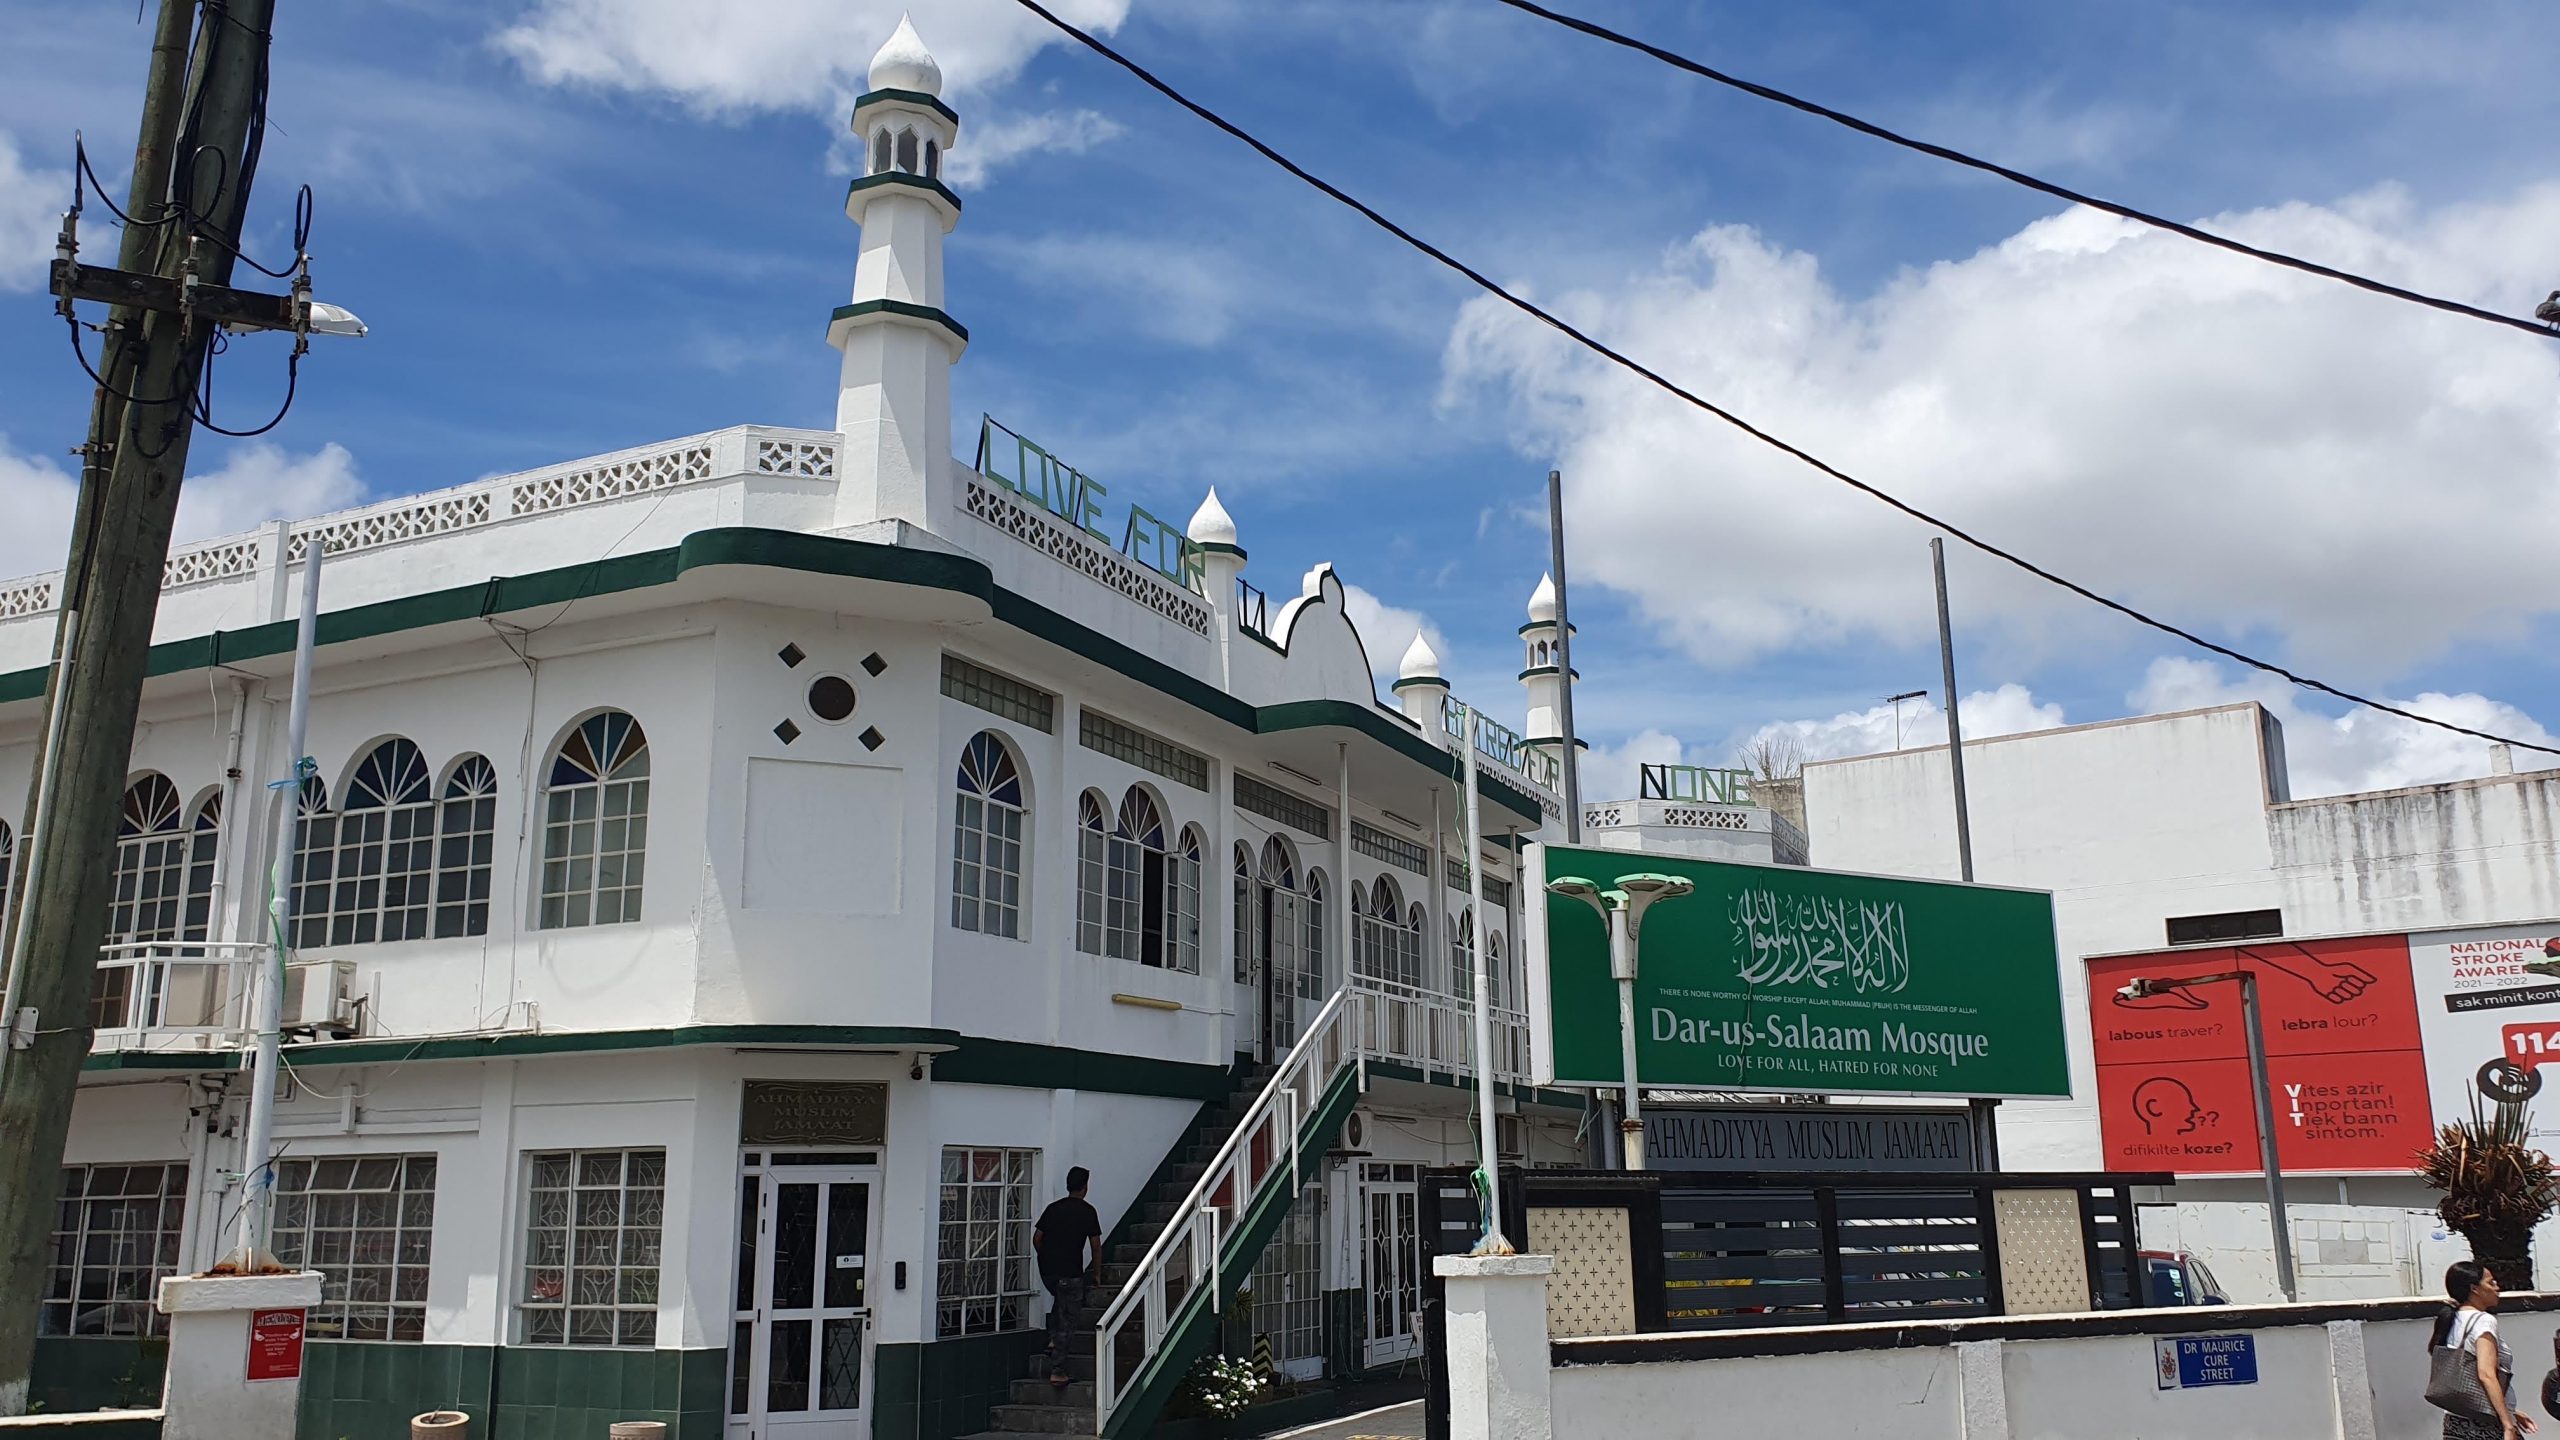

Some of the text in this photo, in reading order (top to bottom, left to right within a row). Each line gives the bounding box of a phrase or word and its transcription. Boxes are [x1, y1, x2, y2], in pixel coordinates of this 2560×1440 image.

[984, 413, 1206, 600] LOVE FOR
[1446, 694, 1521, 775] HTRED
[1640, 763, 1756, 806] NONE
[2450, 939, 2545, 954] NATIONAL
[2451, 952, 2525, 966] STROKE
[2454, 980, 2482, 989] 2021
[2496, 976, 2528, 987] 2022
[1659, 988, 1681, 997] THERE
[1682, 989, 1689, 997] IS
[1690, 990, 1711, 998] NONE
[1712, 991, 1740, 1000] WORTHY
[1752, 994, 1782, 1003] WORSHIP
[1783, 996, 1807, 1004] EXCEPT
[1832, 999, 1871, 1008] MUHAMMAD
[1899, 1003, 1912, 1011] THE
[1912, 1004, 1948, 1013] MESSENGER
[2456, 997, 2482, 1008] sak
[2484, 992, 2524, 1005] minit
[2282, 1013, 2378, 1031] lebra lour?
[1651, 1007, 1989, 1066] Dar-us-Salaam Mosque
[2109, 1023, 2224, 1041] labous traver?
[2510, 1031, 2560, 1054] 114
[1718, 1054, 1939, 1077] LOVE FOR ALL, HATRED FOR NONE
[2284, 1081, 2384, 1098] Vites azir
[754, 1094, 876, 1105] AHMADIYYA
[2291, 1095, 2394, 1115] Inportan!
[773, 1107, 856, 1117] MUSLIM
[2289, 1111, 2398, 1127] Tiek bann
[1648, 1118, 1960, 1160] AHMADIYYA MUSLIM JAMA'AT
[2306, 1126, 2385, 1140] sintom.
[2123, 1142, 2233, 1156] difikilte koze?
[2184, 1340, 2246, 1354] DR MAURICE
[2204, 1354, 2229, 1367] CURE
[2200, 1367, 2234, 1381] STREET
